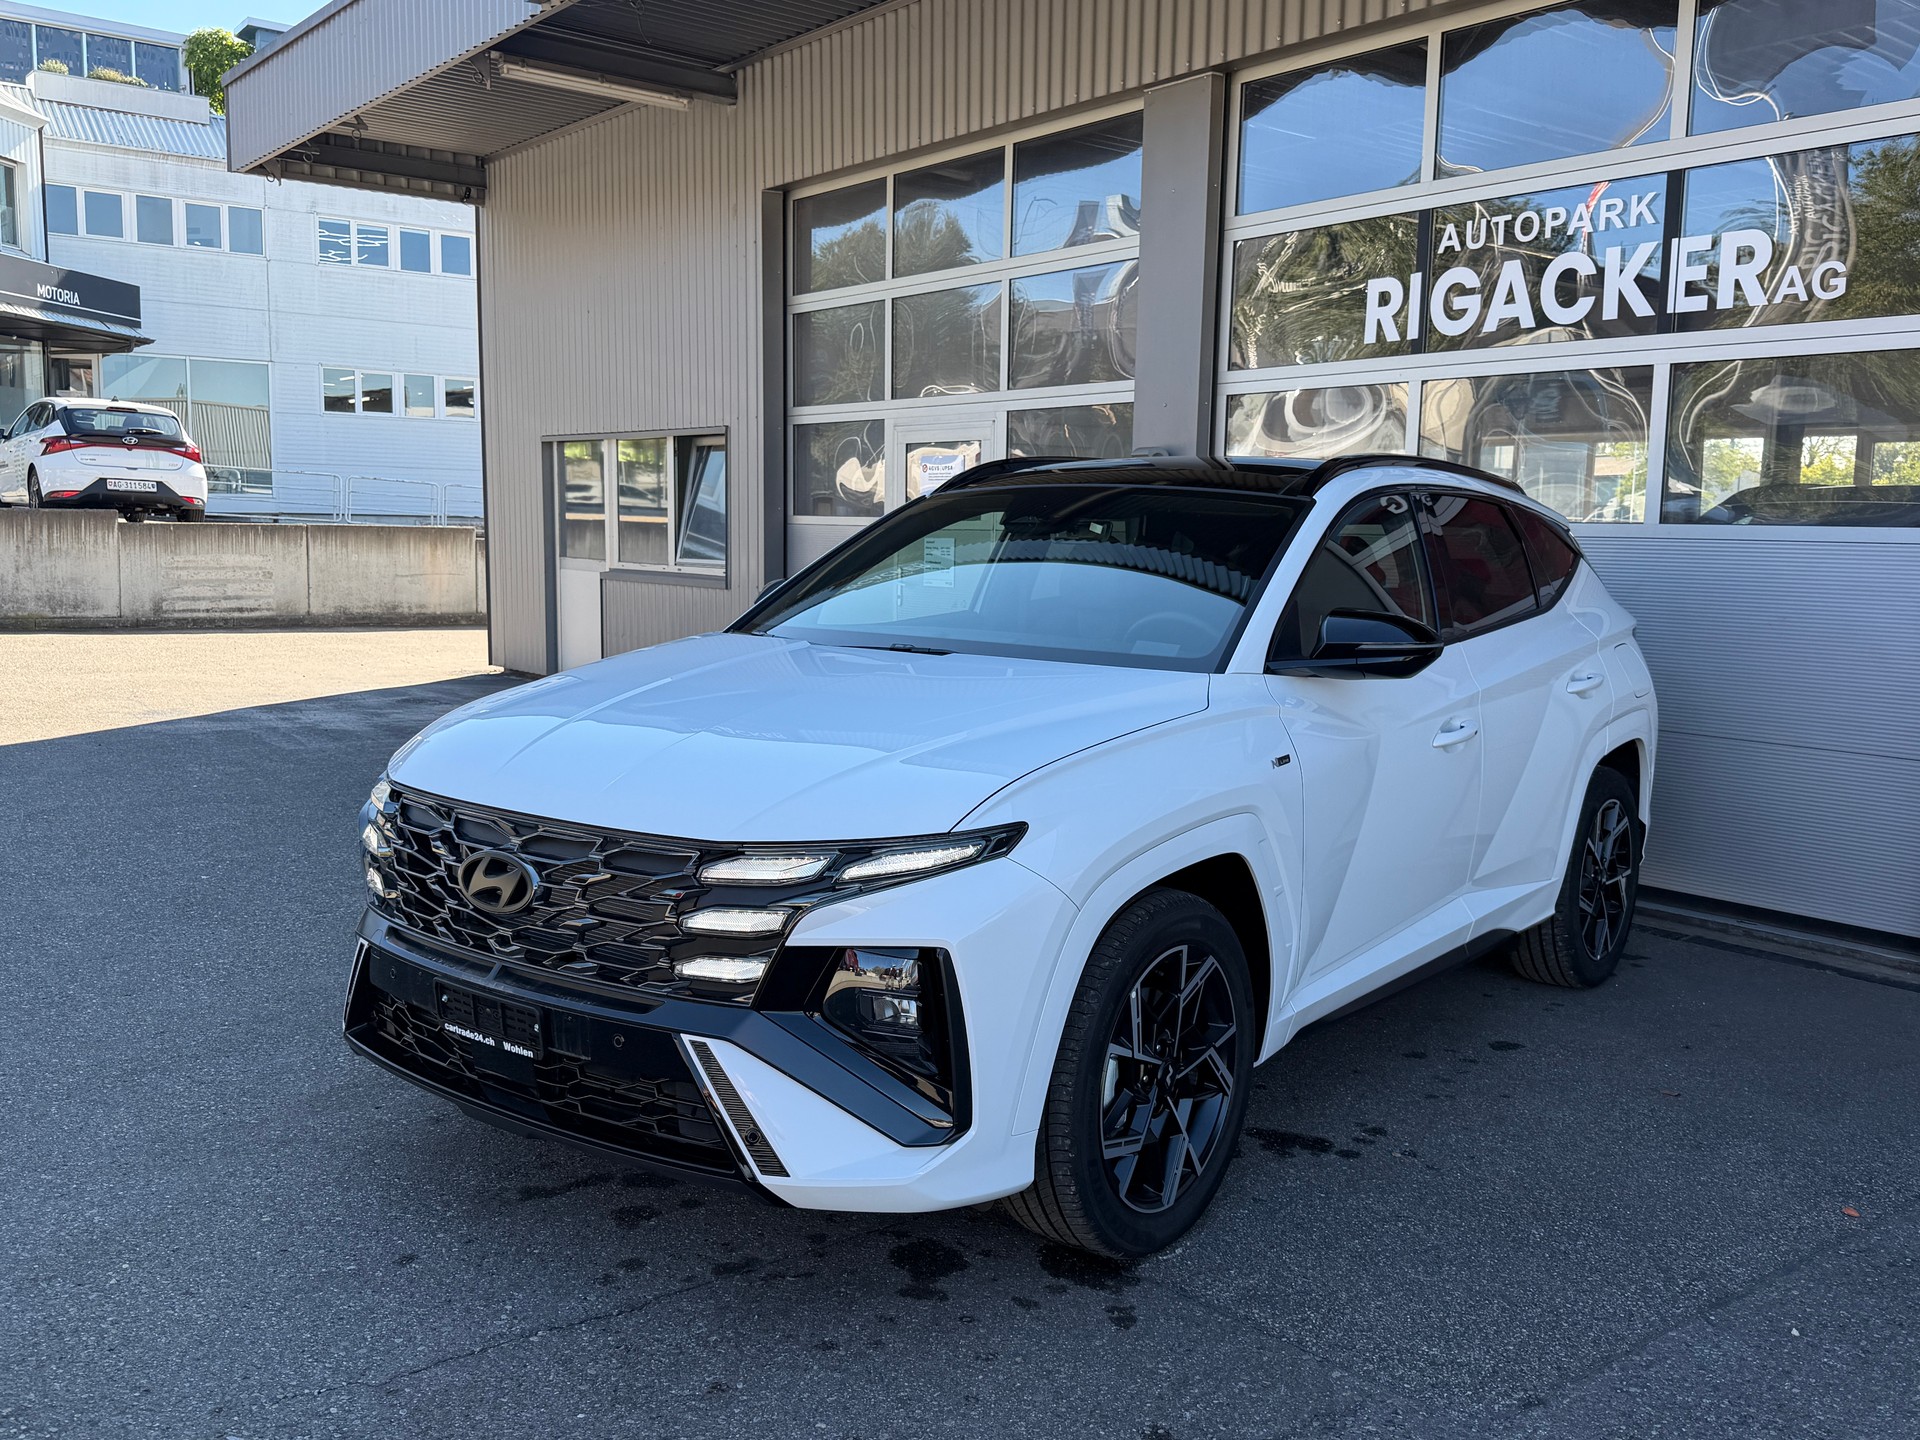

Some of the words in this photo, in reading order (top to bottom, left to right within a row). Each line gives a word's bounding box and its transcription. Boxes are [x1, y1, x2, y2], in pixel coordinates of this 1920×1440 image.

[1437, 191, 1658, 254] AUTOPARK
[37, 283, 80, 305] MOTORIA
[1363, 229, 1774, 345] RIGACKER
[1772, 260, 1848, 304] AG
[444, 1022, 496, 1047] cartrade24.ch
[503, 1041, 534, 1058] Wohlen
